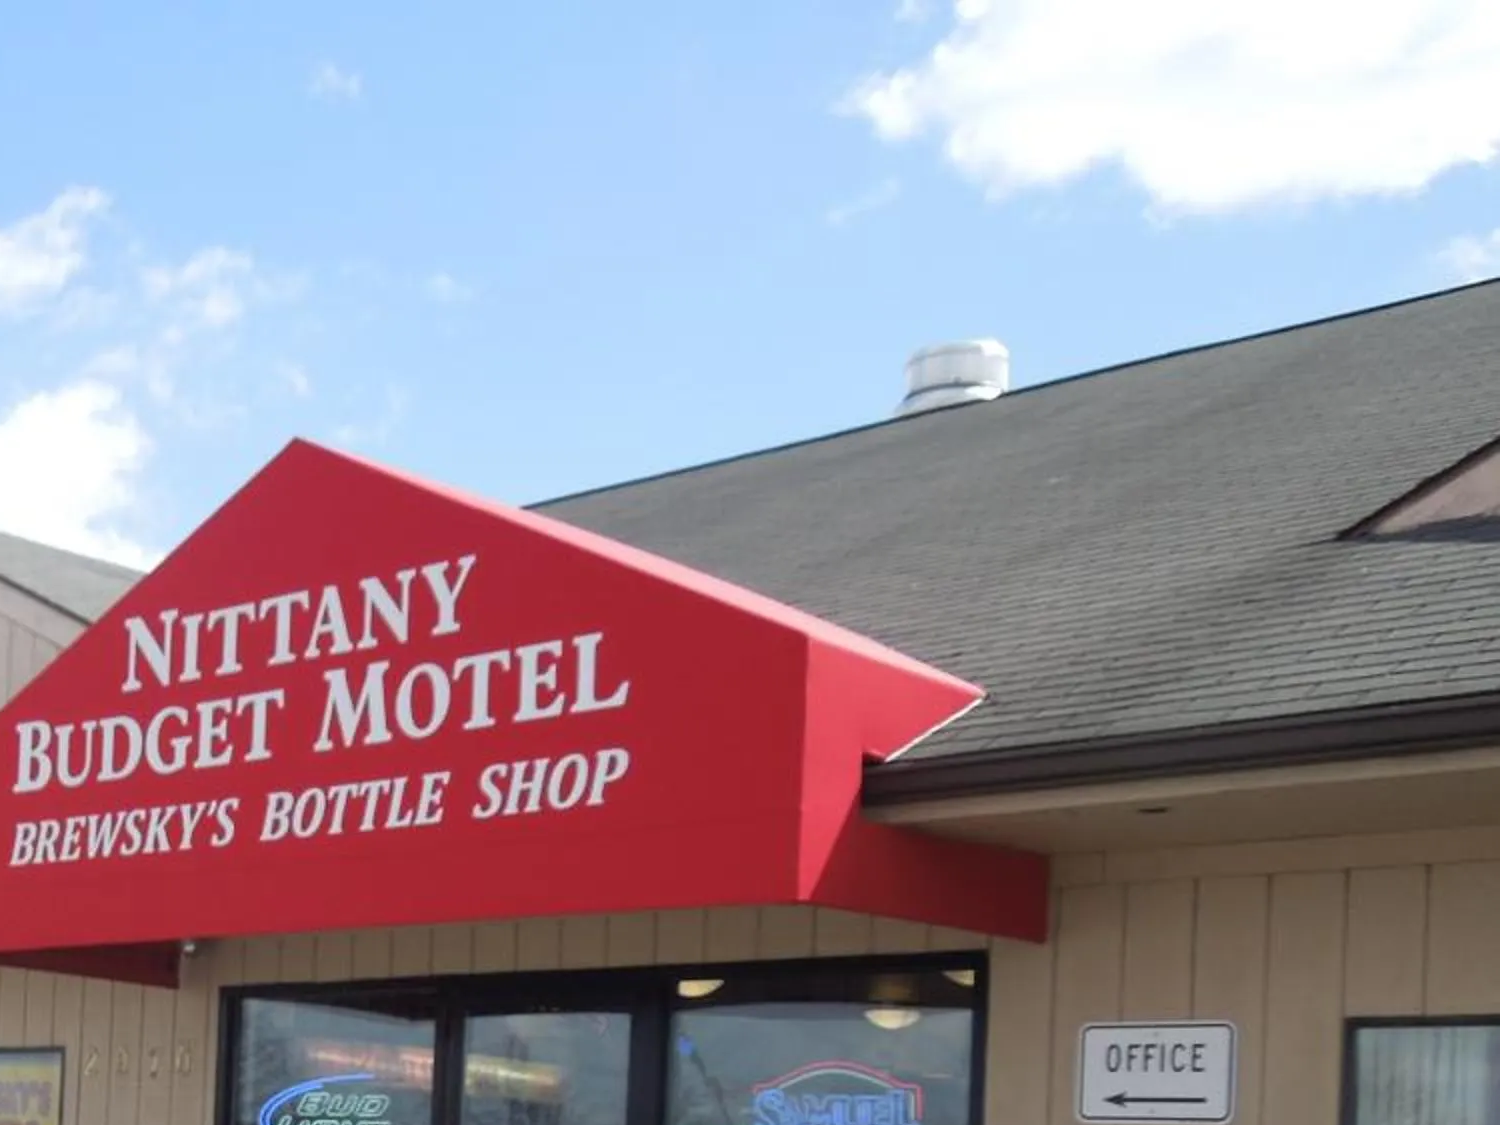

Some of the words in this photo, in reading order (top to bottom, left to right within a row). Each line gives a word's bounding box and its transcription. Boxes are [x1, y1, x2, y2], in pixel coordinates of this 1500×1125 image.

[121, 554, 476, 693] NITTANY
[12, 688, 285, 794] BUDGET
[313, 632, 630, 752] MOTEL
[9, 798, 240, 867] BREWSKY'S
[259, 771, 451, 842] BOTTLE
[472, 748, 630, 820] SHOP
[297, 1091, 390, 1118] BUD
[1106, 1043, 1207, 1073] OFFICE
